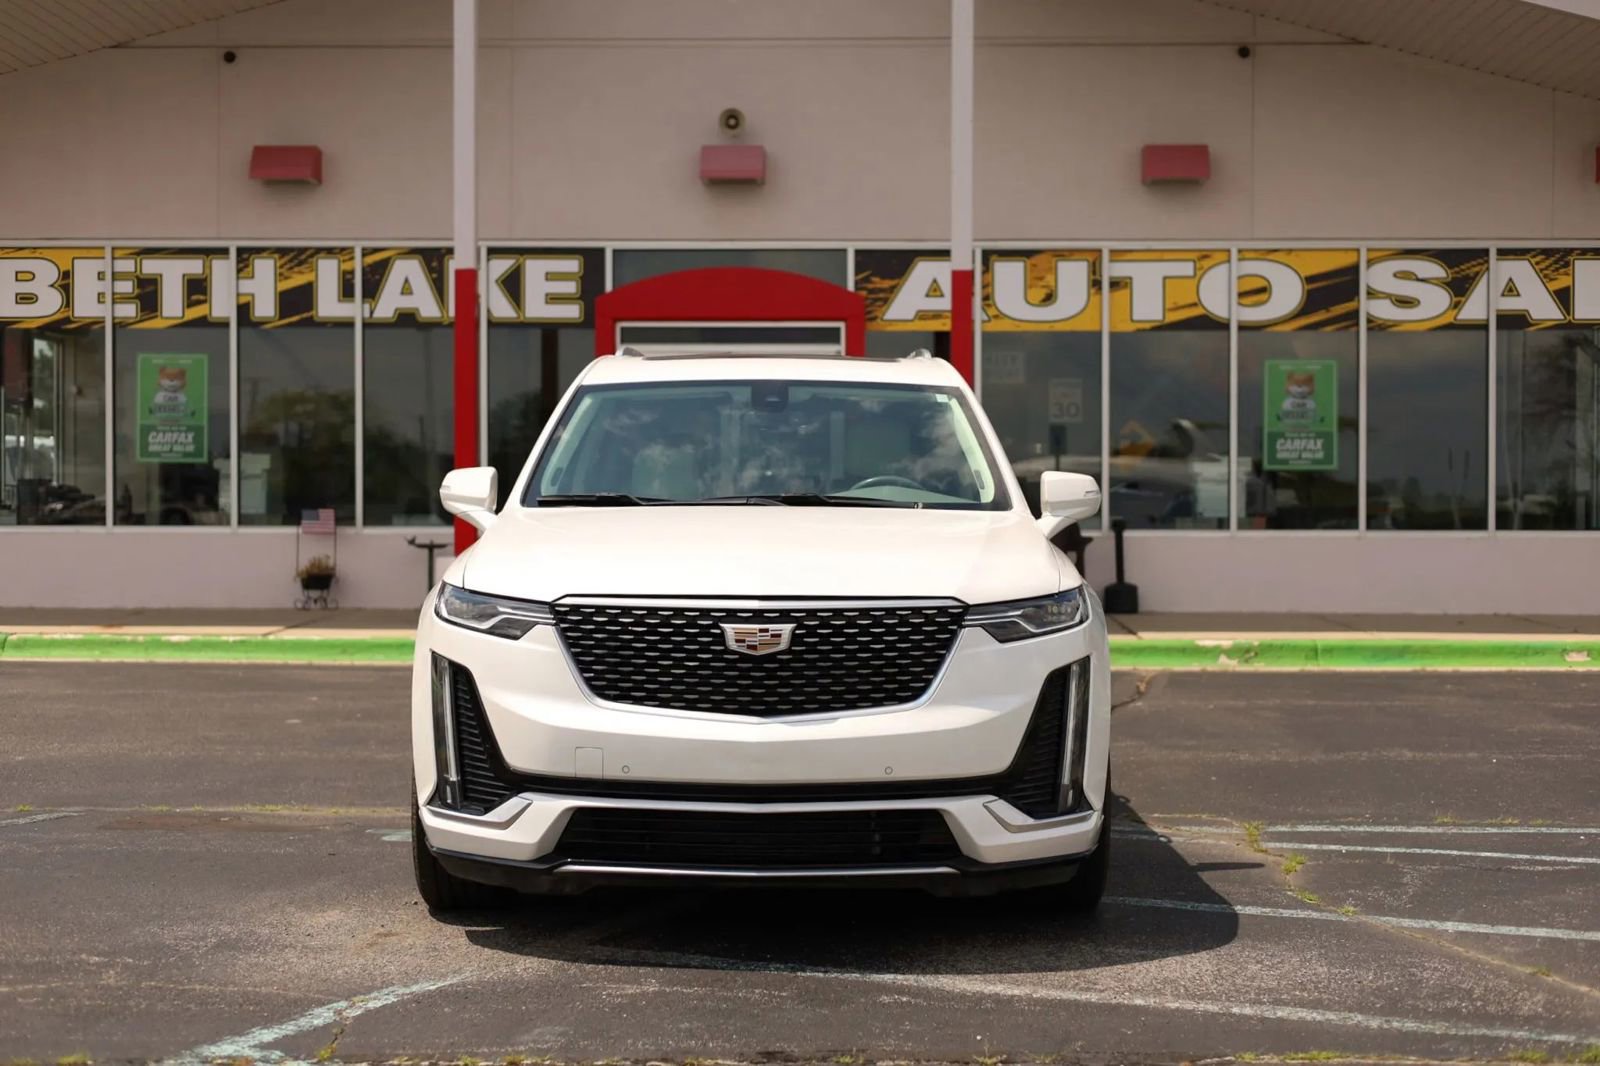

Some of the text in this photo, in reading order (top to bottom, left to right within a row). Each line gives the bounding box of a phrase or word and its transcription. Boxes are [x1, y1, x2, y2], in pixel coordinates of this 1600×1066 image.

[314, 255, 584, 322] LAKE
[880, 256, 1307, 325] AUTO
[1052, 402, 1080, 419] 30
[148, 431, 195, 443] CARFAX
[1276, 438, 1324, 450] CARFAX
